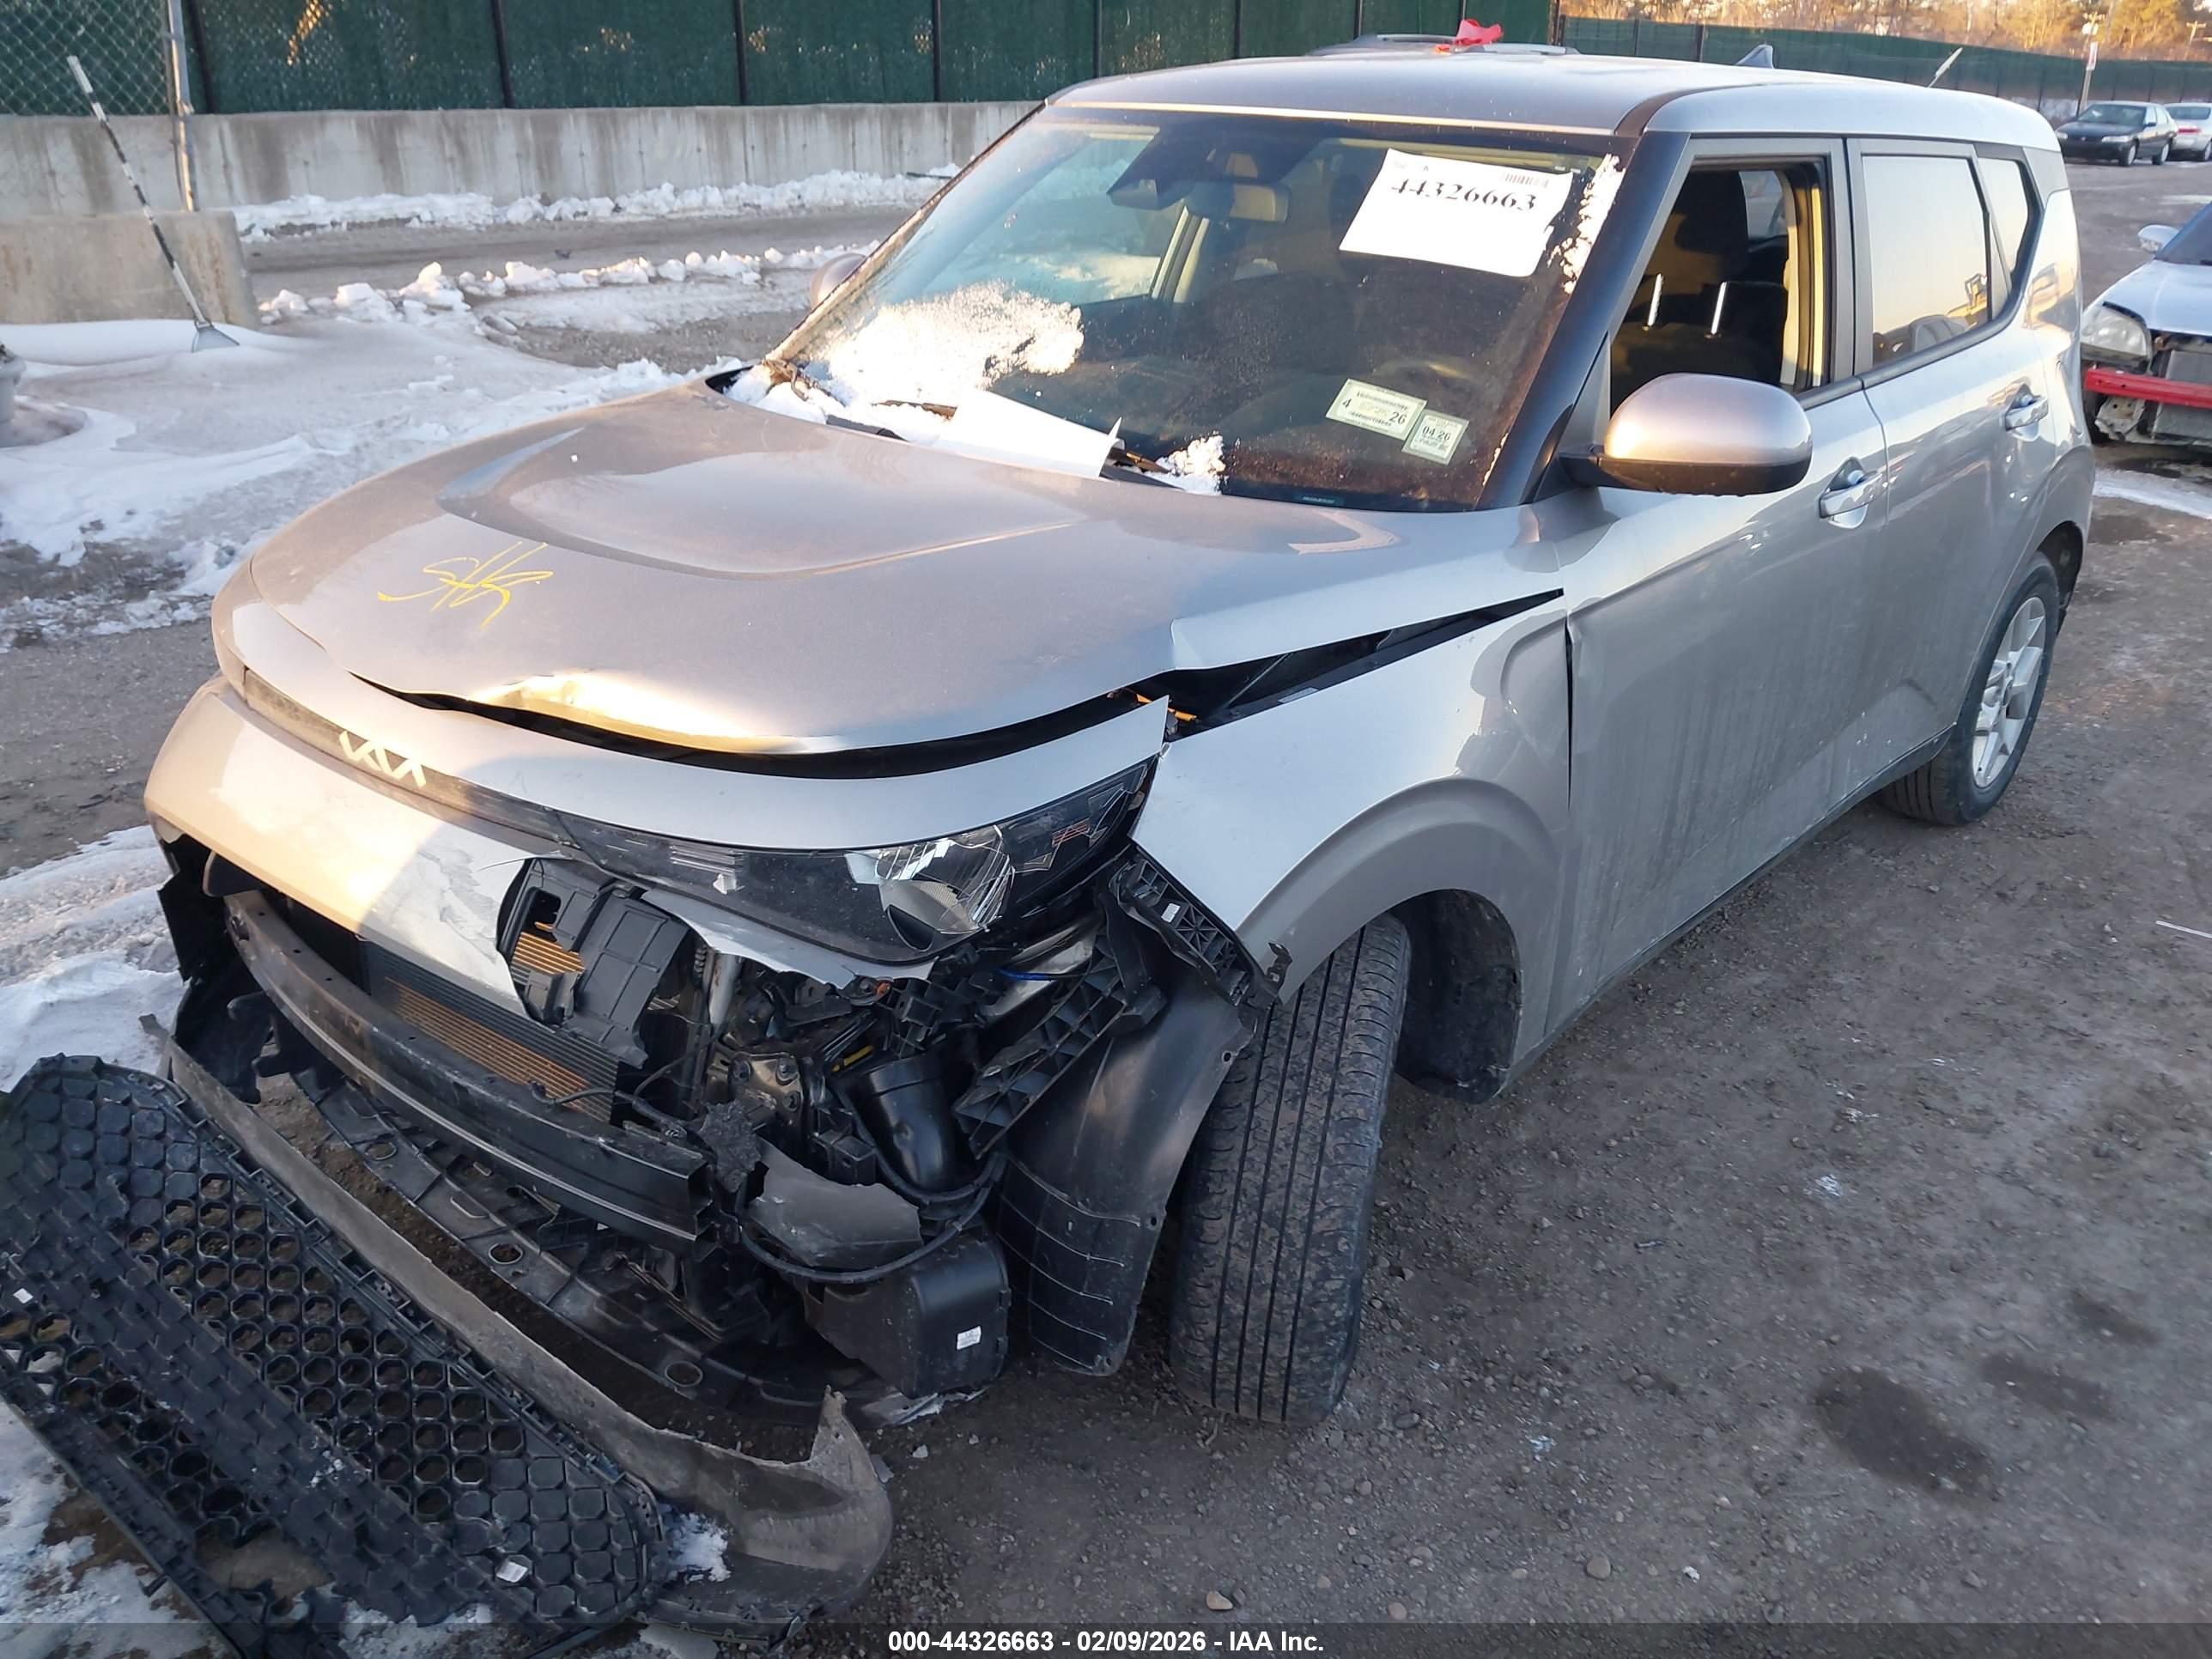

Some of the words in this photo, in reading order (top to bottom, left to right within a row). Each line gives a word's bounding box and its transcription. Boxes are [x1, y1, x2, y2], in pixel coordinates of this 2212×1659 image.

[1391, 178, 1536, 211] 44326663
[1342, 398, 1352, 409] 4
[1389, 411, 1407, 424] 26
